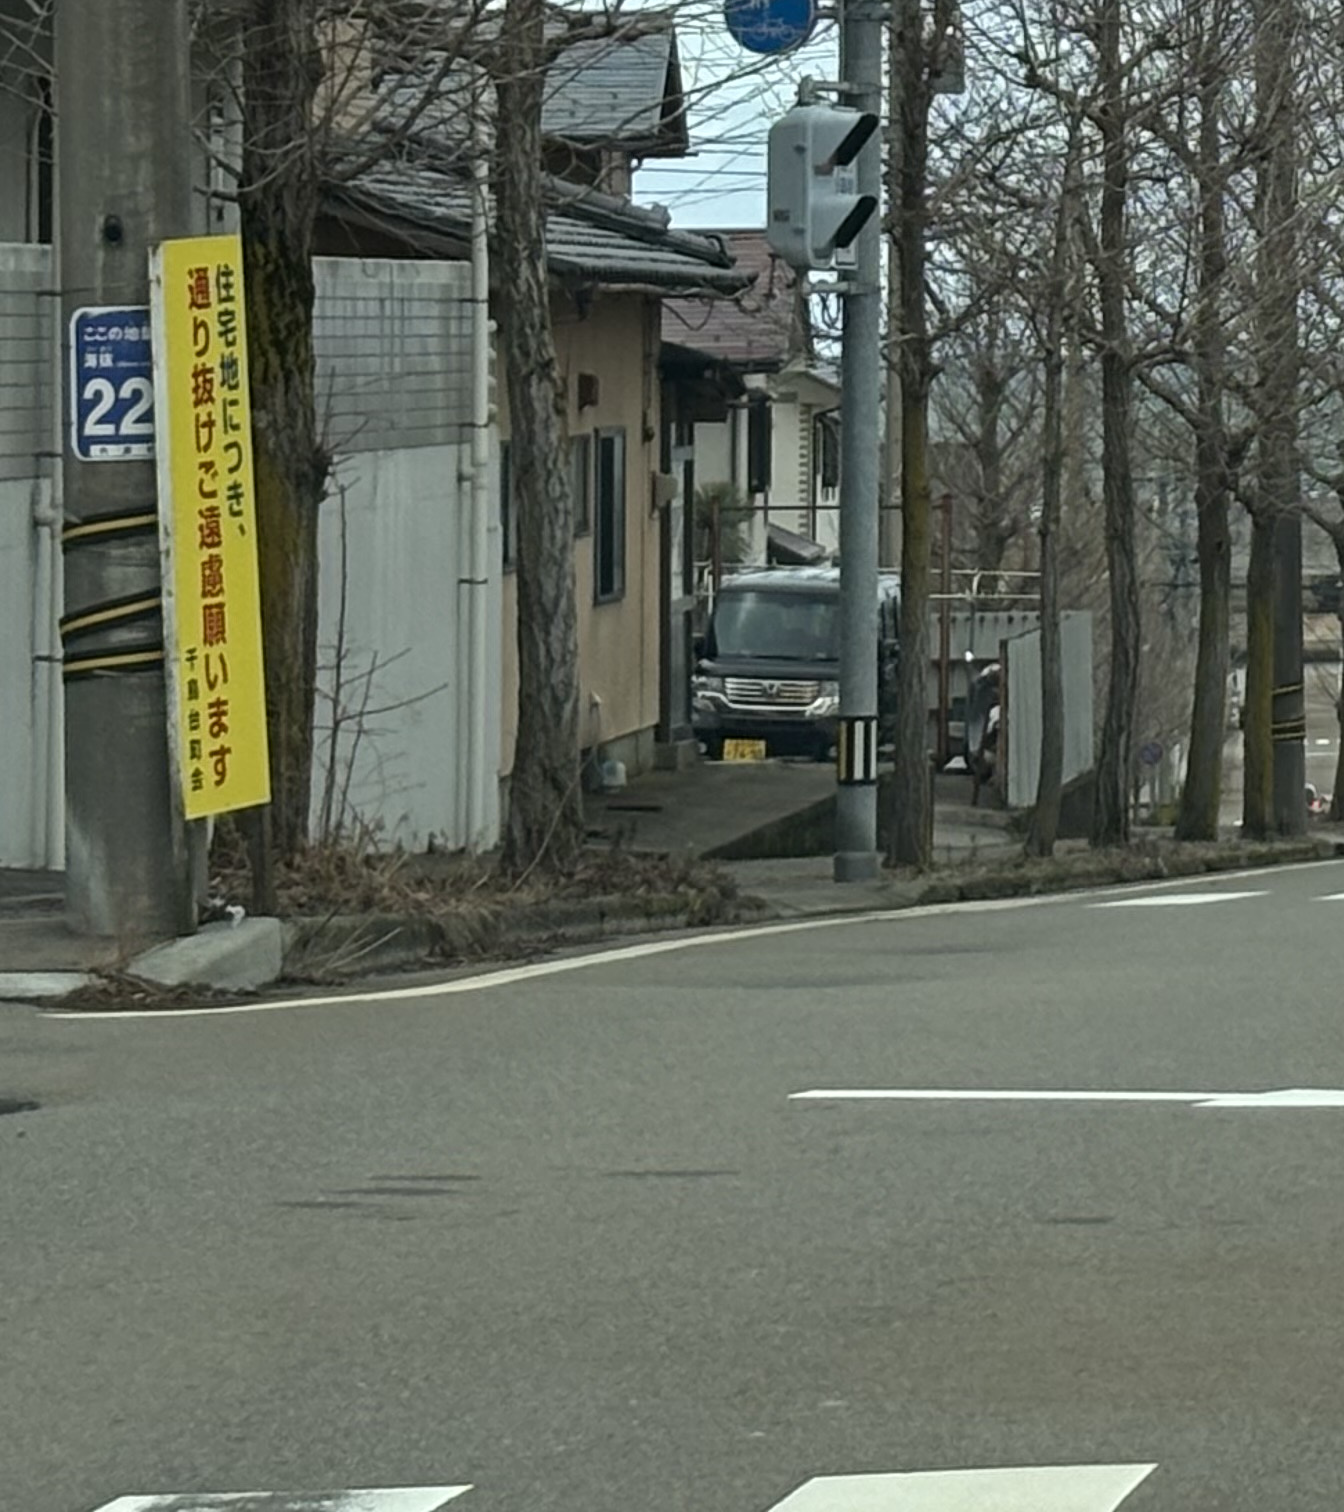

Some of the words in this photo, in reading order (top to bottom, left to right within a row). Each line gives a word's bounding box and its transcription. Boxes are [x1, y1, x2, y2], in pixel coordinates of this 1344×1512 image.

[82, 376, 155, 437] 22
[187, 268, 232, 788] 通り抜けご遠慮願います
[215, 264, 248, 538] 住宅地につき、
